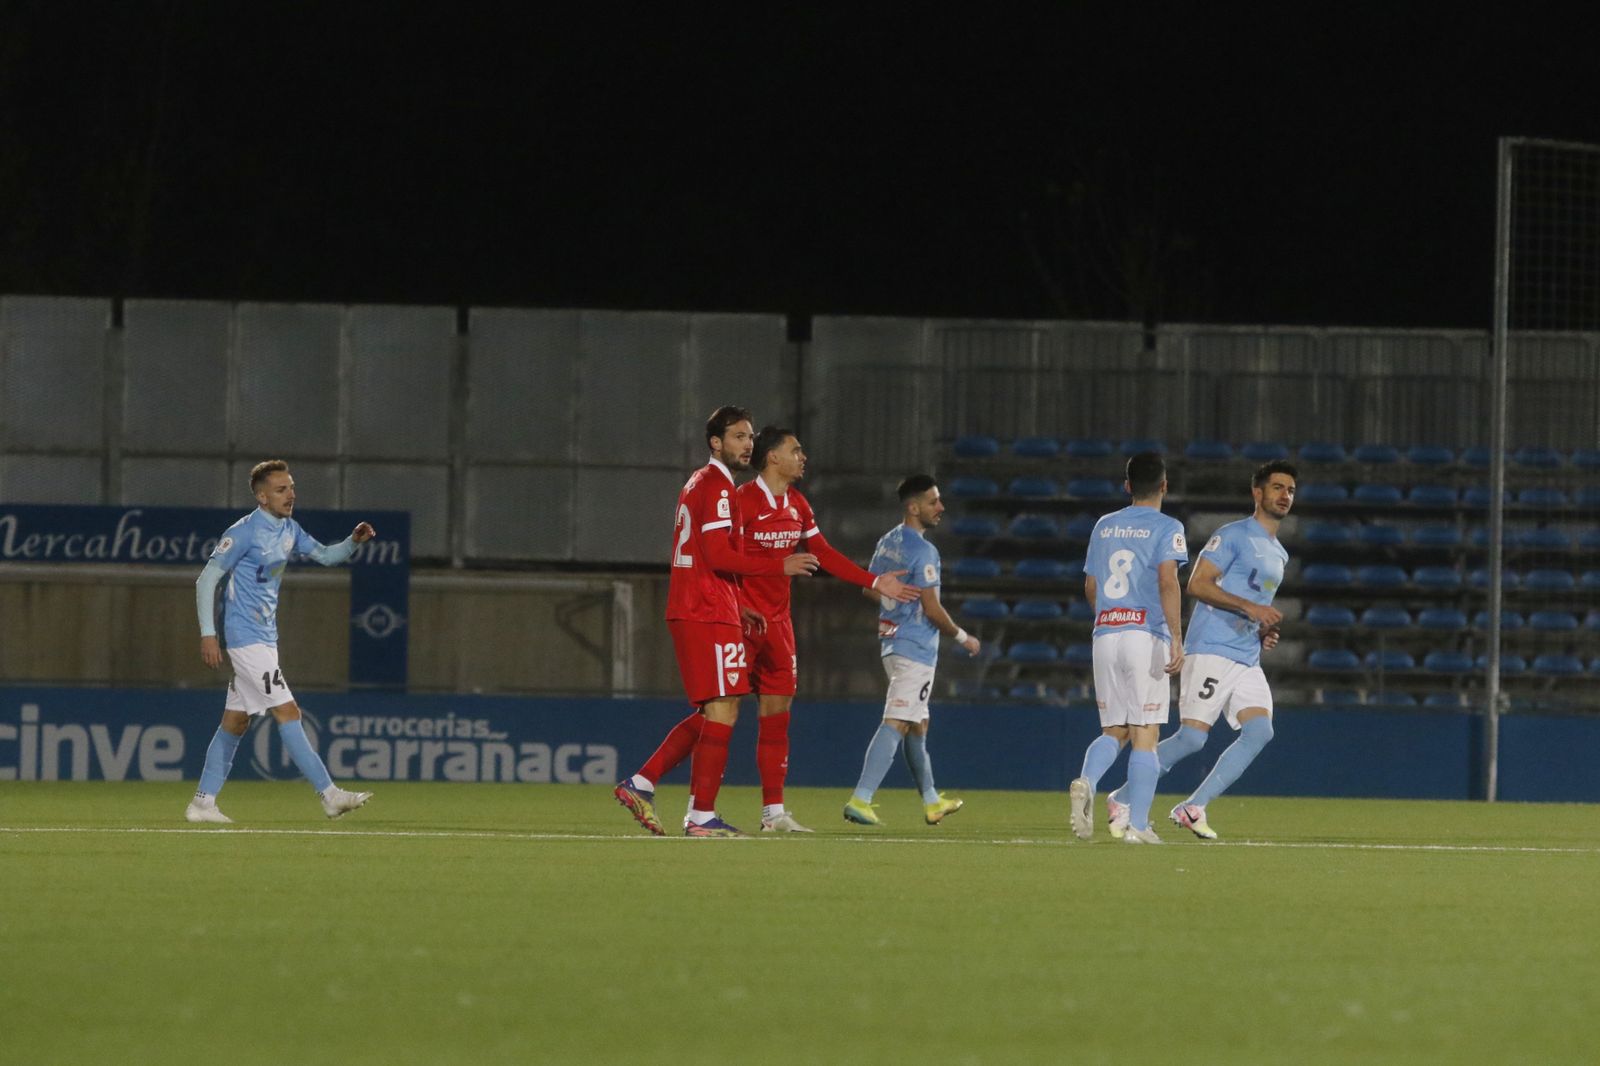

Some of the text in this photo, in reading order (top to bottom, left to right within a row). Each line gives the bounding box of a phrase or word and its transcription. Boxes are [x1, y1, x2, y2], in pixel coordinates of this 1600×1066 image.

[754, 530, 801, 541] MARATHO
[773, 539, 791, 549] BET
[1104, 549, 1135, 599] 8
[724, 642, 747, 668] 22
[262, 669, 285, 695] 14
[919, 681, 931, 701] 6
[1198, 677, 1219, 700] 5
